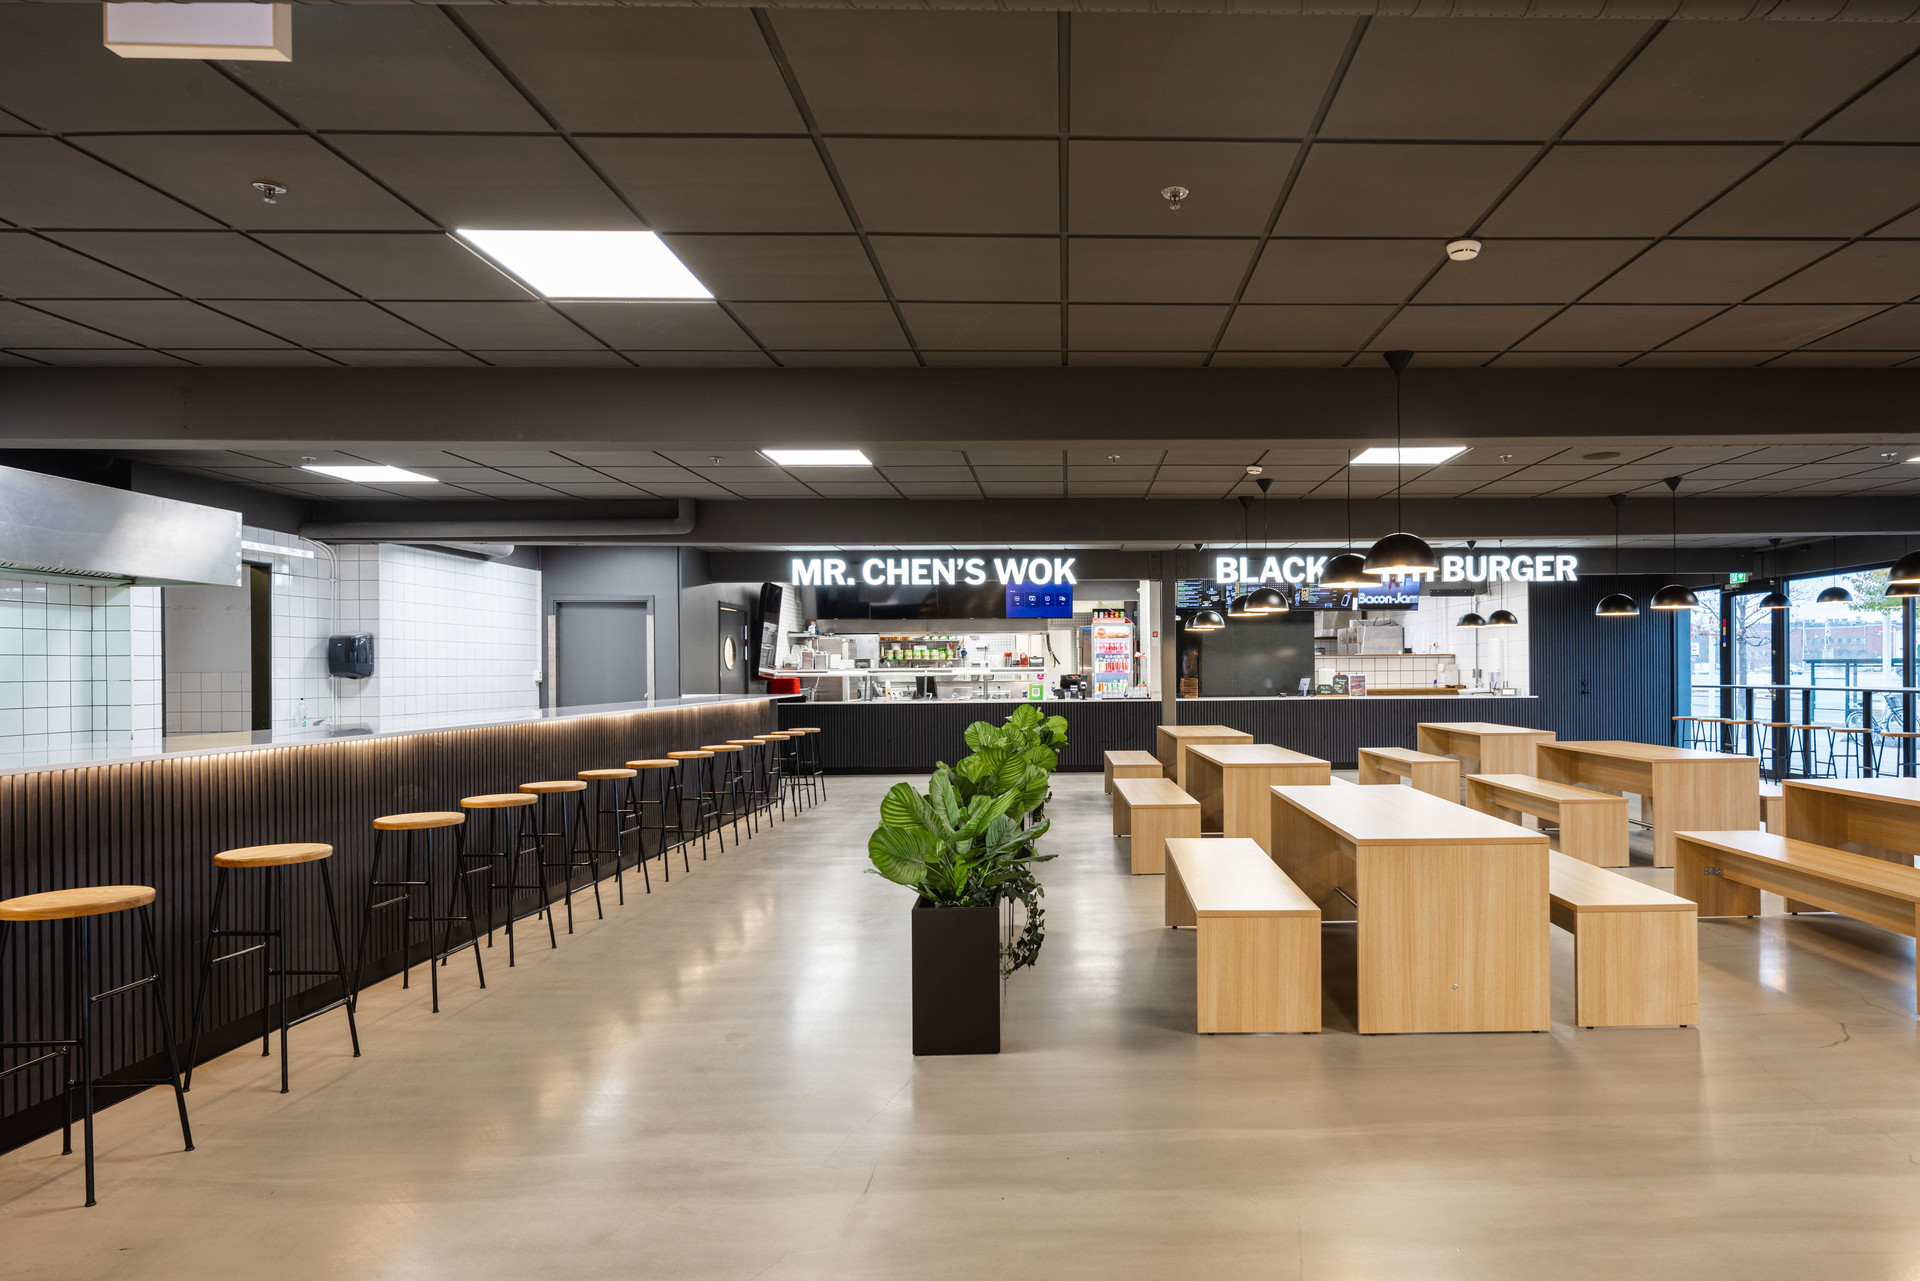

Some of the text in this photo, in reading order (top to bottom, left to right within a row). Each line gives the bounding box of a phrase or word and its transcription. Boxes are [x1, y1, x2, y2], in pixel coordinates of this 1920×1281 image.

[791, 557, 1077, 586] MR. CHEN'S WOK
[1442, 555, 1578, 582] BURGER
[1358, 592, 1418, 604] Bacon-Jam
